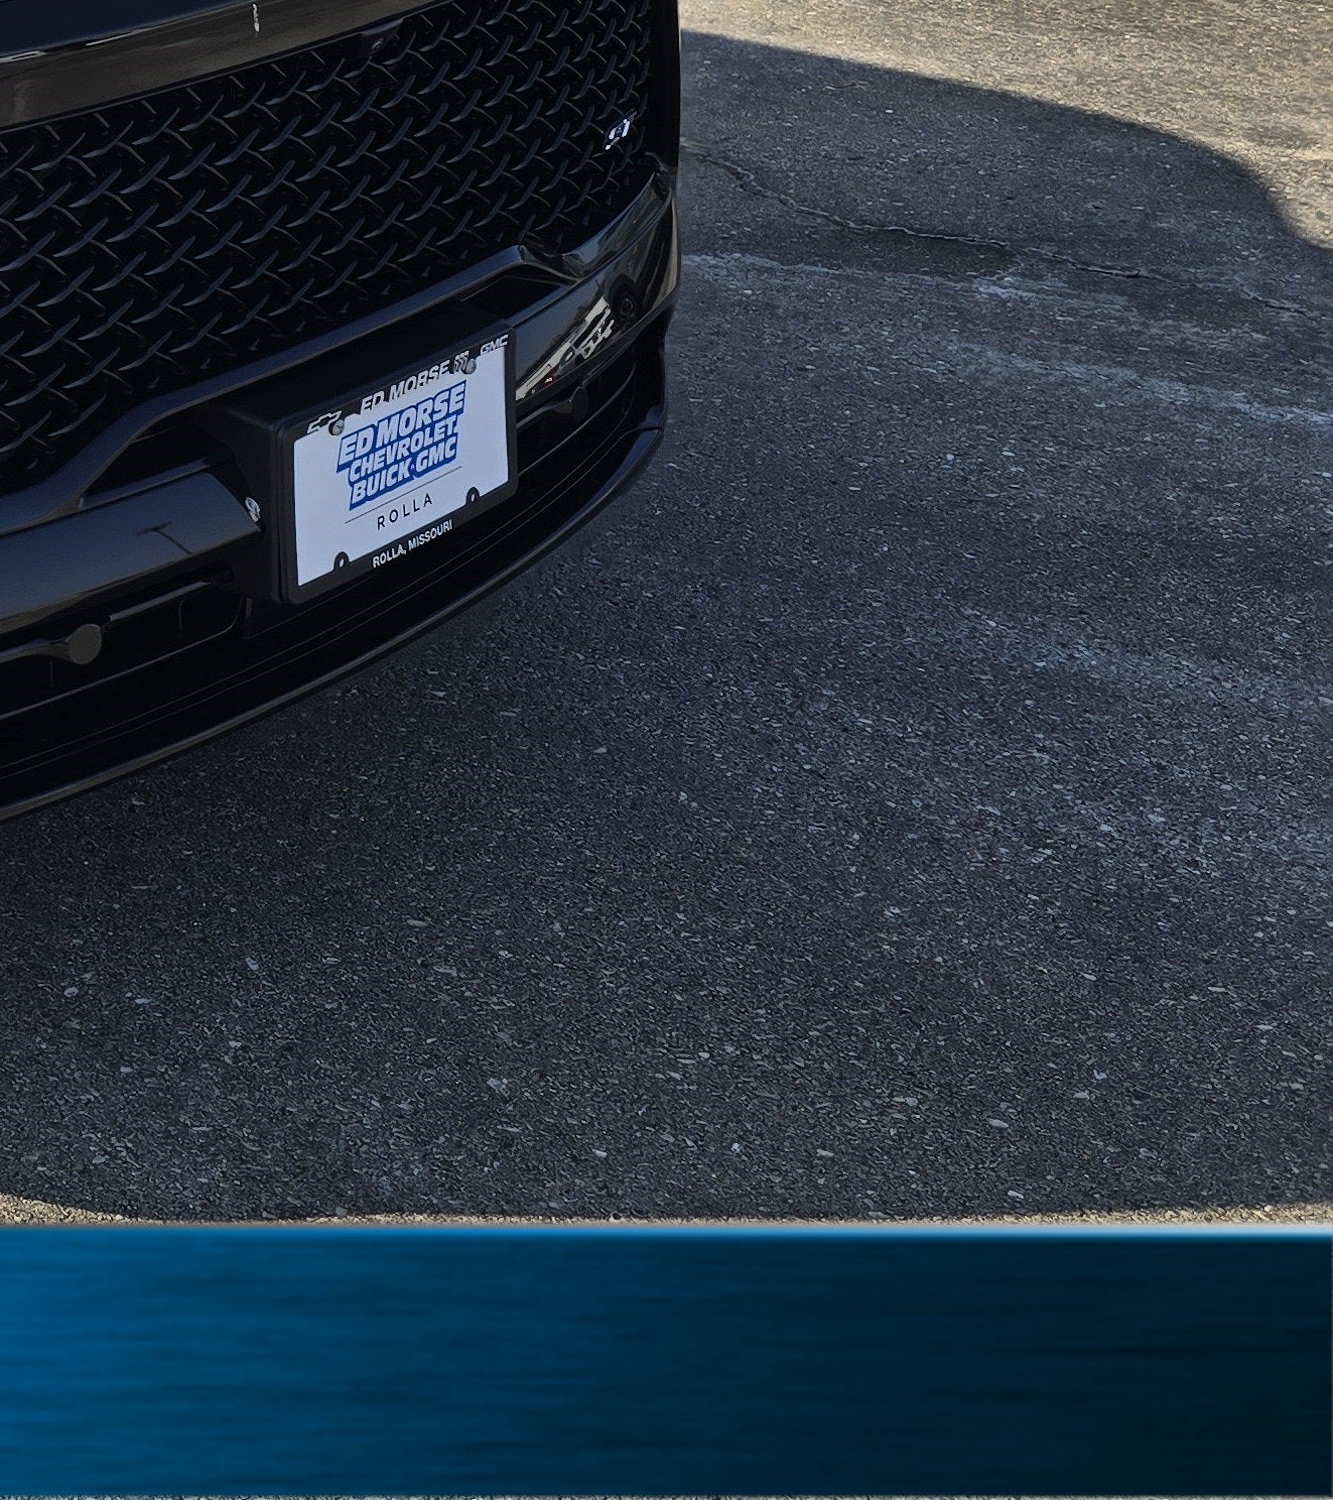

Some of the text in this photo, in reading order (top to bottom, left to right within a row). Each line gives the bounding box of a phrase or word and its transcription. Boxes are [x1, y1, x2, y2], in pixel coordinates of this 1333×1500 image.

[360, 334, 509, 415] ED MORSE GMC
[339, 382, 465, 466] ED MORSE
[350, 416, 458, 483] CHEVROLET
[352, 435, 457, 504] BUICK GMC
[373, 519, 453, 569] ROLLA, MISSOURI
[377, 492, 433, 531] ROLLA
